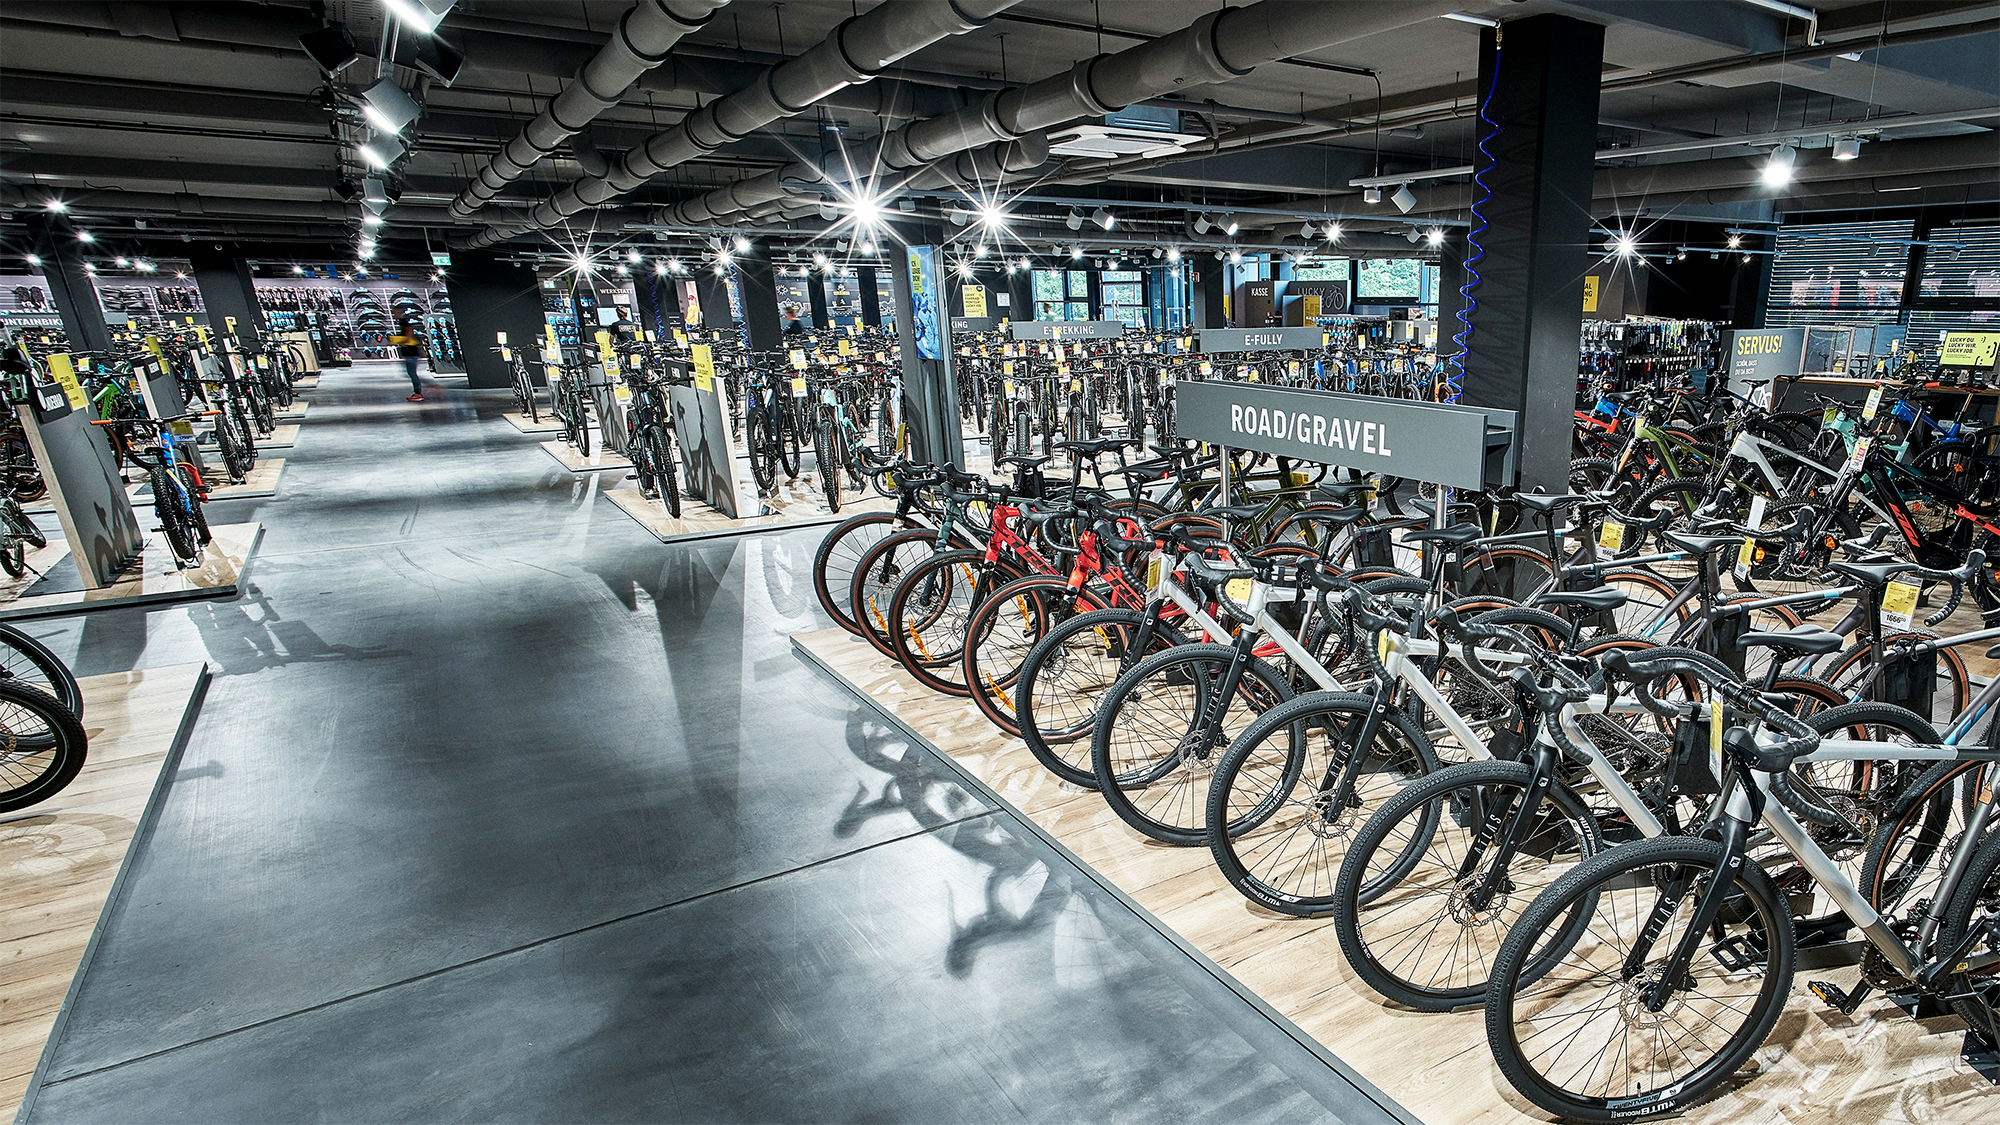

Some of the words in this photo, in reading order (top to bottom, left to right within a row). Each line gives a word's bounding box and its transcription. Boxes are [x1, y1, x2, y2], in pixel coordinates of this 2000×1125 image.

[1251, 287, 1269, 297] KASSE
[1297, 287, 1326, 297] LUCKY
[1584, 290, 1593, 298] NG
[0, 318, 64, 326] UNTAINBIK
[951, 321, 968, 329] KING
[1043, 325, 1095, 336] E-REKKING
[1245, 333, 1283, 346] E-FULLY
[1737, 335, 1783, 356] SERVUS!
[1231, 404, 1392, 457] ROAD/GRAVEL
[1888, 502, 1921, 548] KTM
[1011, 536, 1060, 575] TRE
[1105, 568, 1144, 612] TRE
[1205, 688, 1222, 722] ATLAS
[1329, 741, 1352, 778] ATLAS
[1474, 814, 1502, 855] ATLAS
[1581, 819, 1595, 841] WTB
[1257, 892, 1277, 906] WTB
[1645, 896, 1678, 943] ATLAS
[1641, 1102, 1669, 1116] WTB
